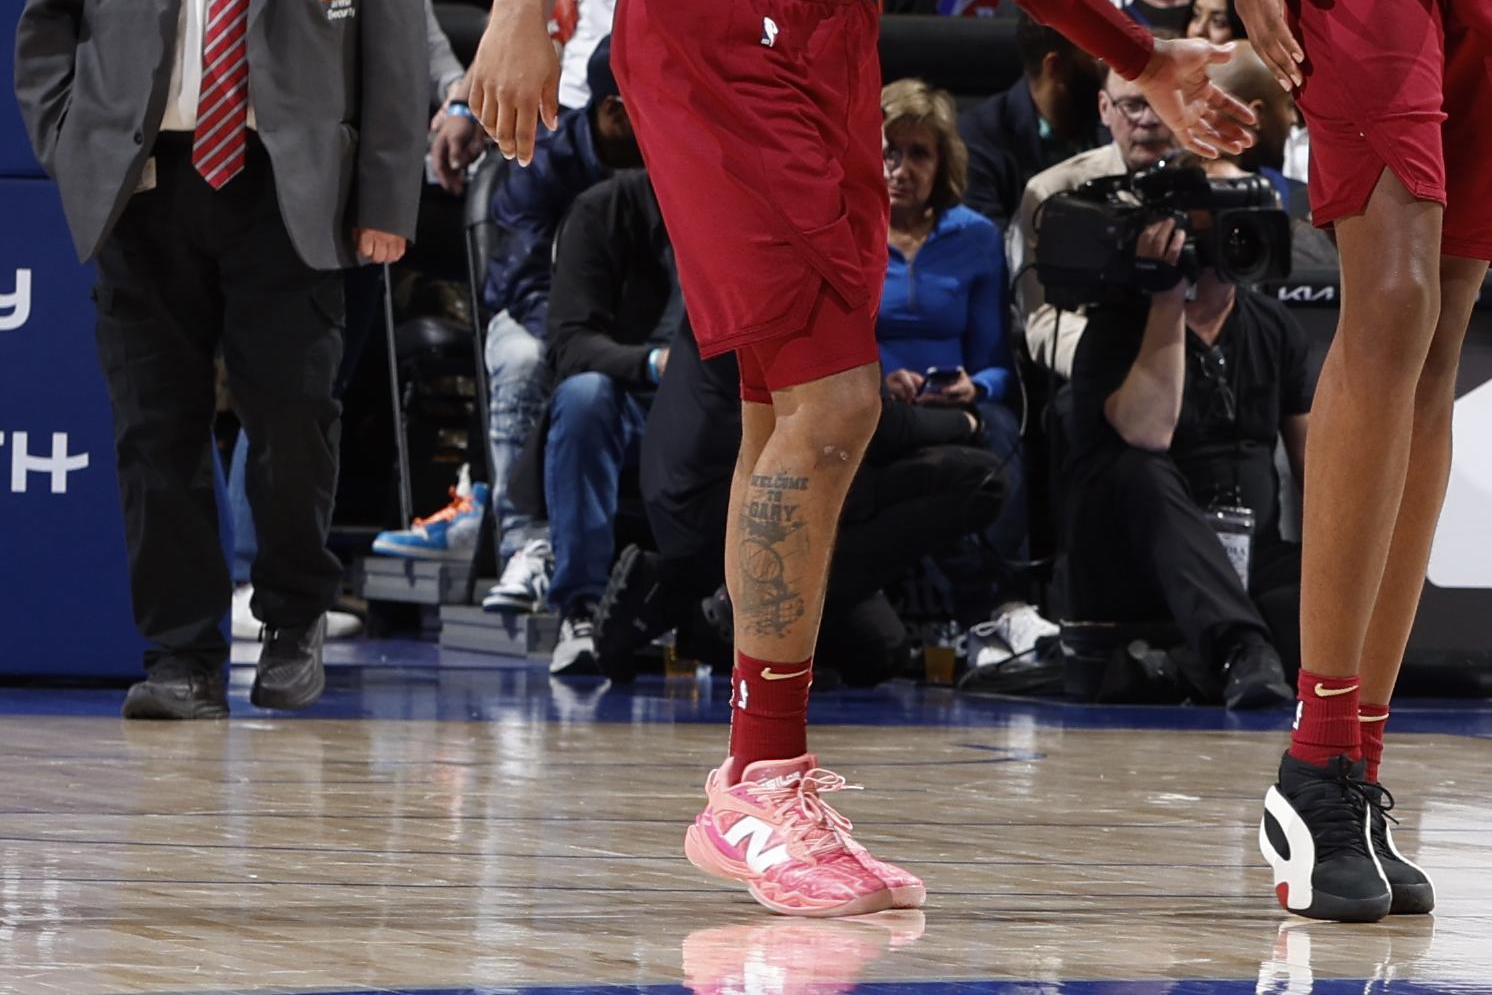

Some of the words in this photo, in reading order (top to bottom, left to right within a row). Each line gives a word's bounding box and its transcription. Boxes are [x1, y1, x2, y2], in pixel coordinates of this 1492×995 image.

[1278, 286, 1335, 301] KIA
[751, 475, 809, 491] WELCOME
[767, 491, 783, 503] TO
[749, 501, 799, 523] GARY
